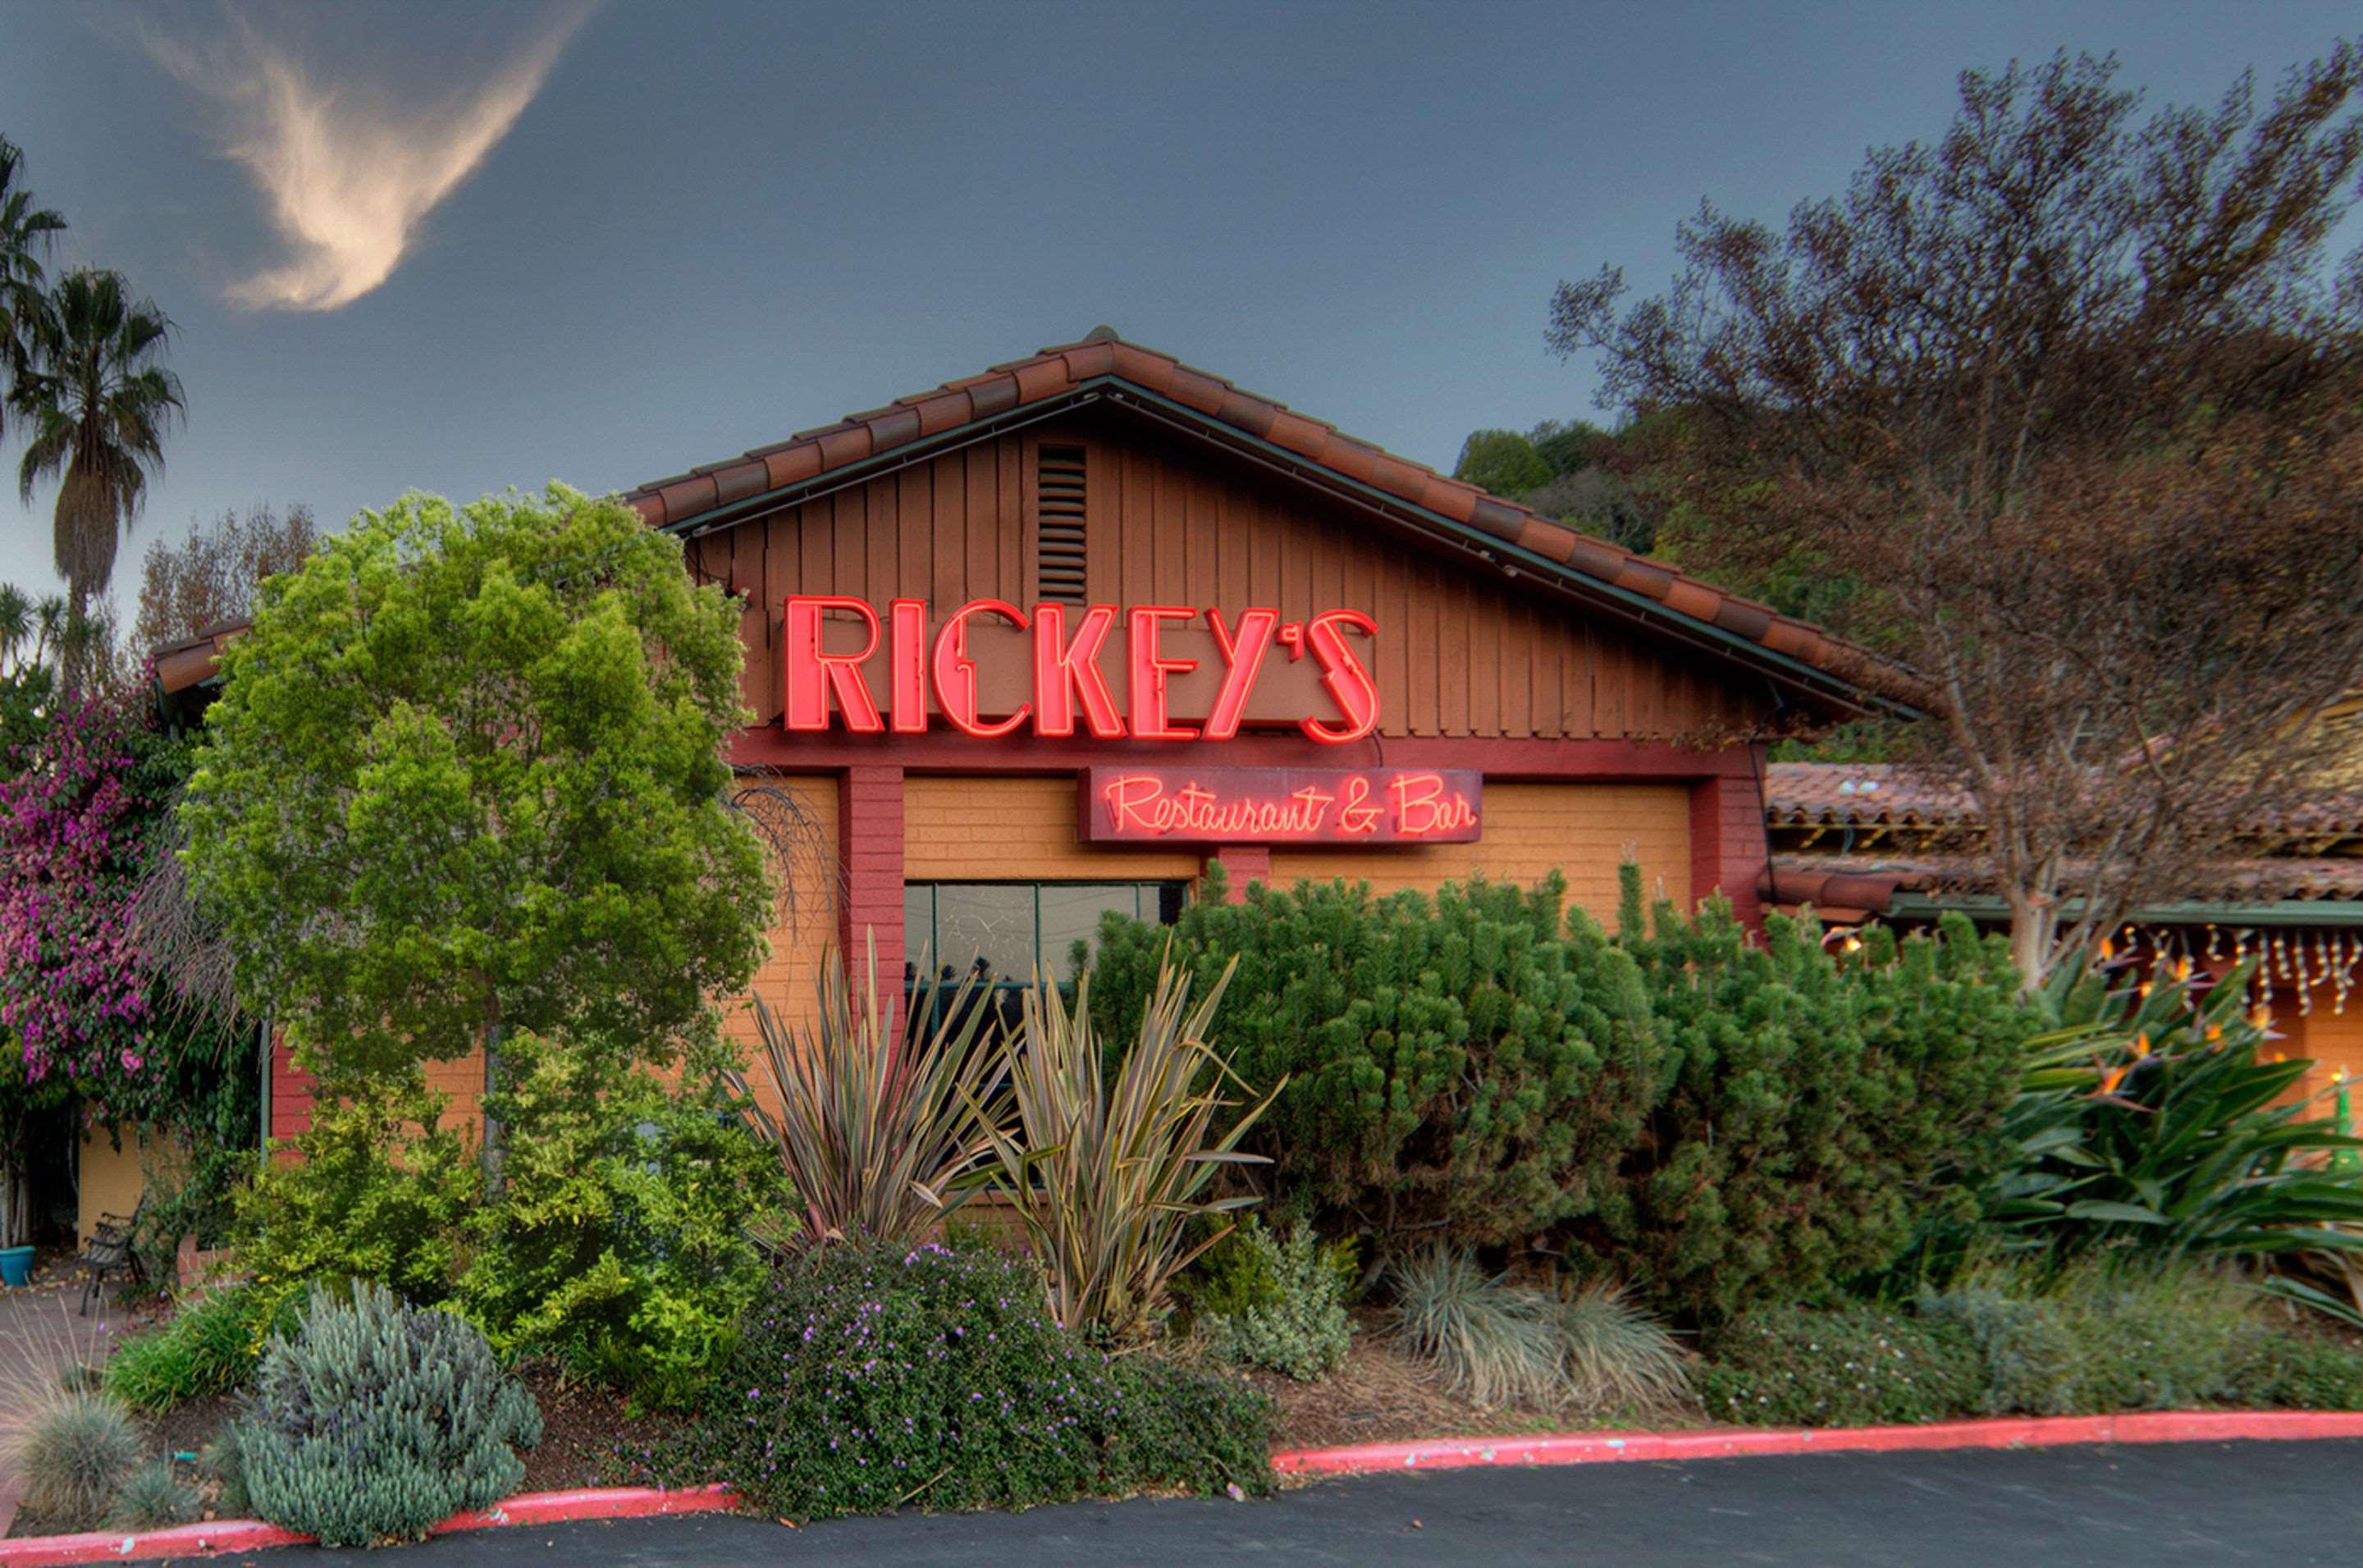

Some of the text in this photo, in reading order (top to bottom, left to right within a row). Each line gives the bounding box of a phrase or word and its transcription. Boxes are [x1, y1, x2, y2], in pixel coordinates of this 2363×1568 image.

[784, 596, 1381, 744] RICKEY'S
[1105, 774, 1476, 834] Restaurant & Bar
